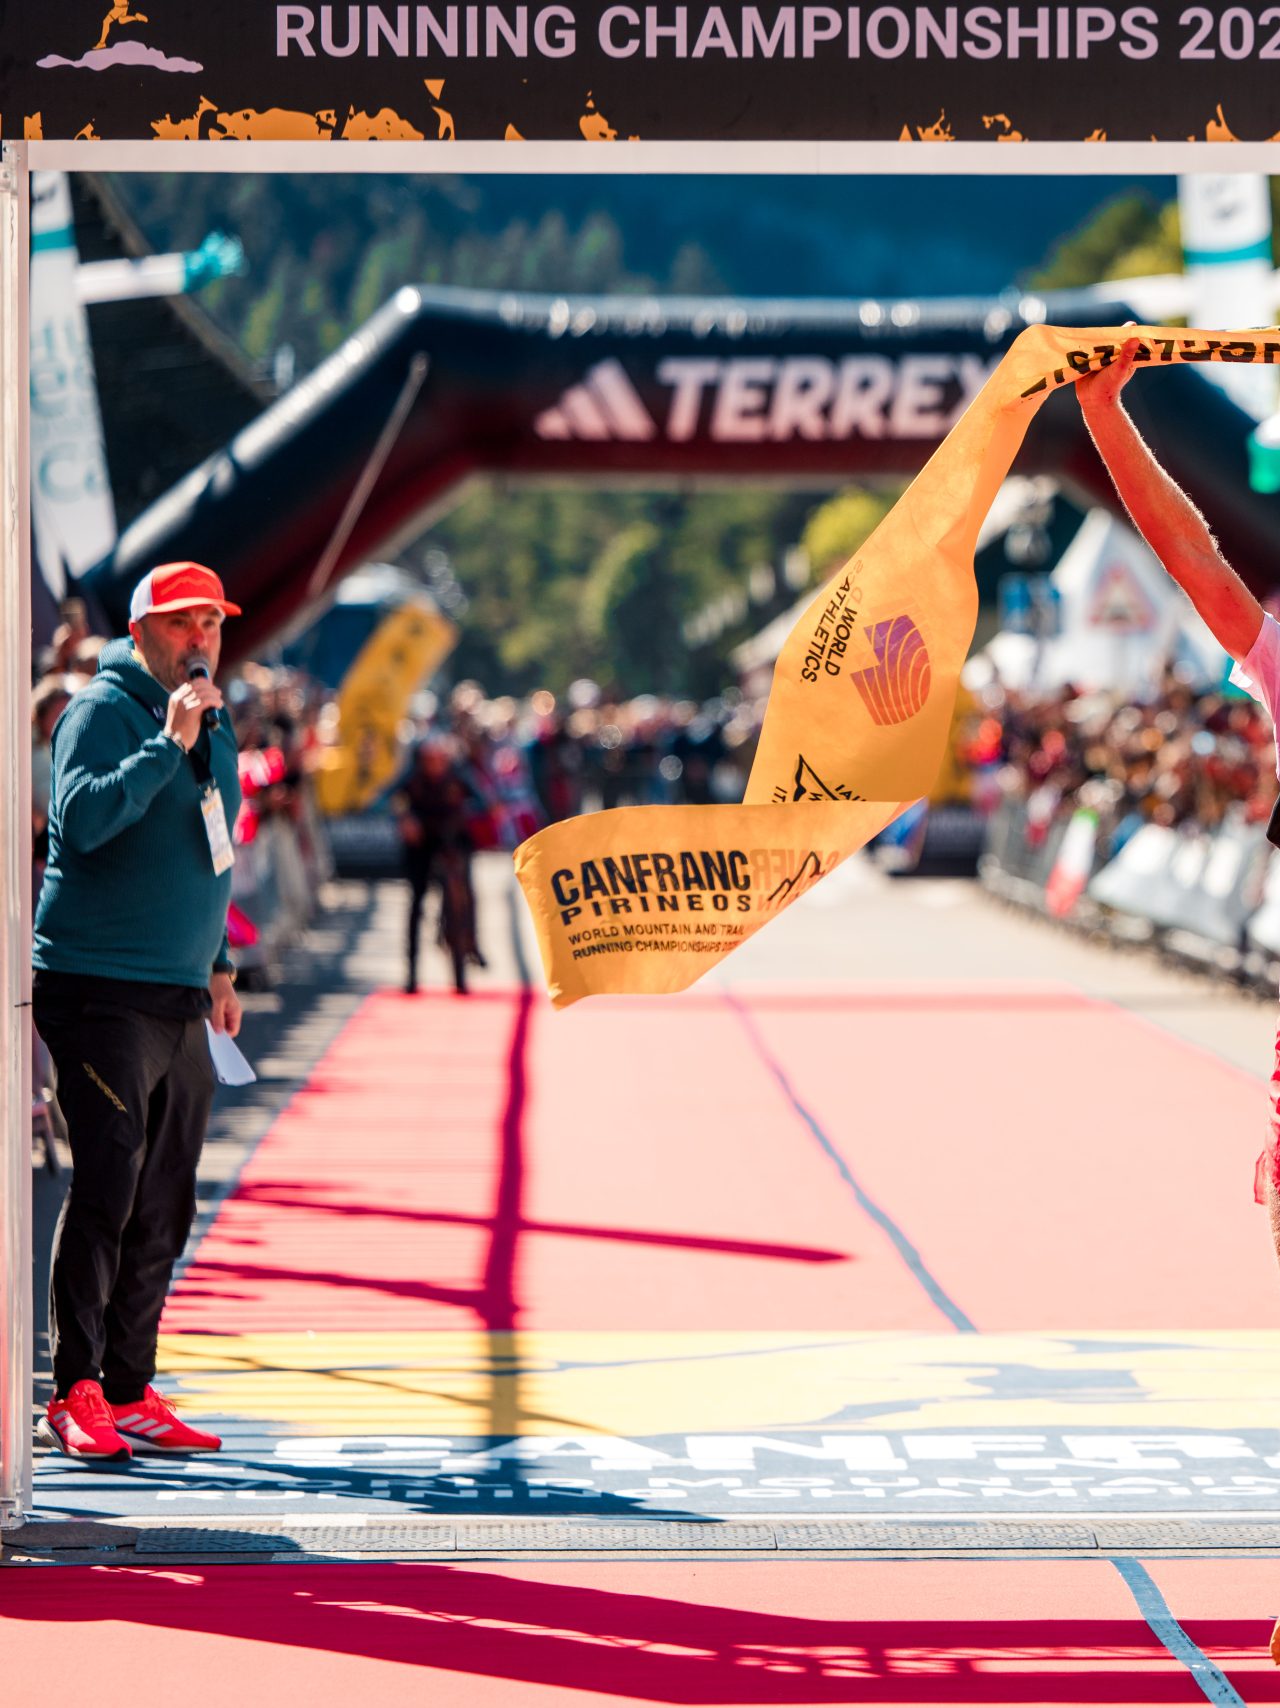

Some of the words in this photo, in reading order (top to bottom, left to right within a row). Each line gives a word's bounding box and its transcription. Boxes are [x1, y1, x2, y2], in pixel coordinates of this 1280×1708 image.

[275, 5, 577, 59] RUNNING
[598, 5, 1160, 60] CHAMPIONSHIPS
[801, 575, 852, 683] ATHLETICS
[825, 608, 858, 677] WORLD
[550, 849, 751, 907] CANFRANC
[560, 894, 752, 926] PIRINEOS
[568, 926, 619, 945] WORLD
[623, 923, 691, 937] MOUNTAIN
[695, 923, 717, 935] AND
[572, 940, 633, 960] RUNNING
[635, 940, 720, 953] CHAMPIONSHIPS
